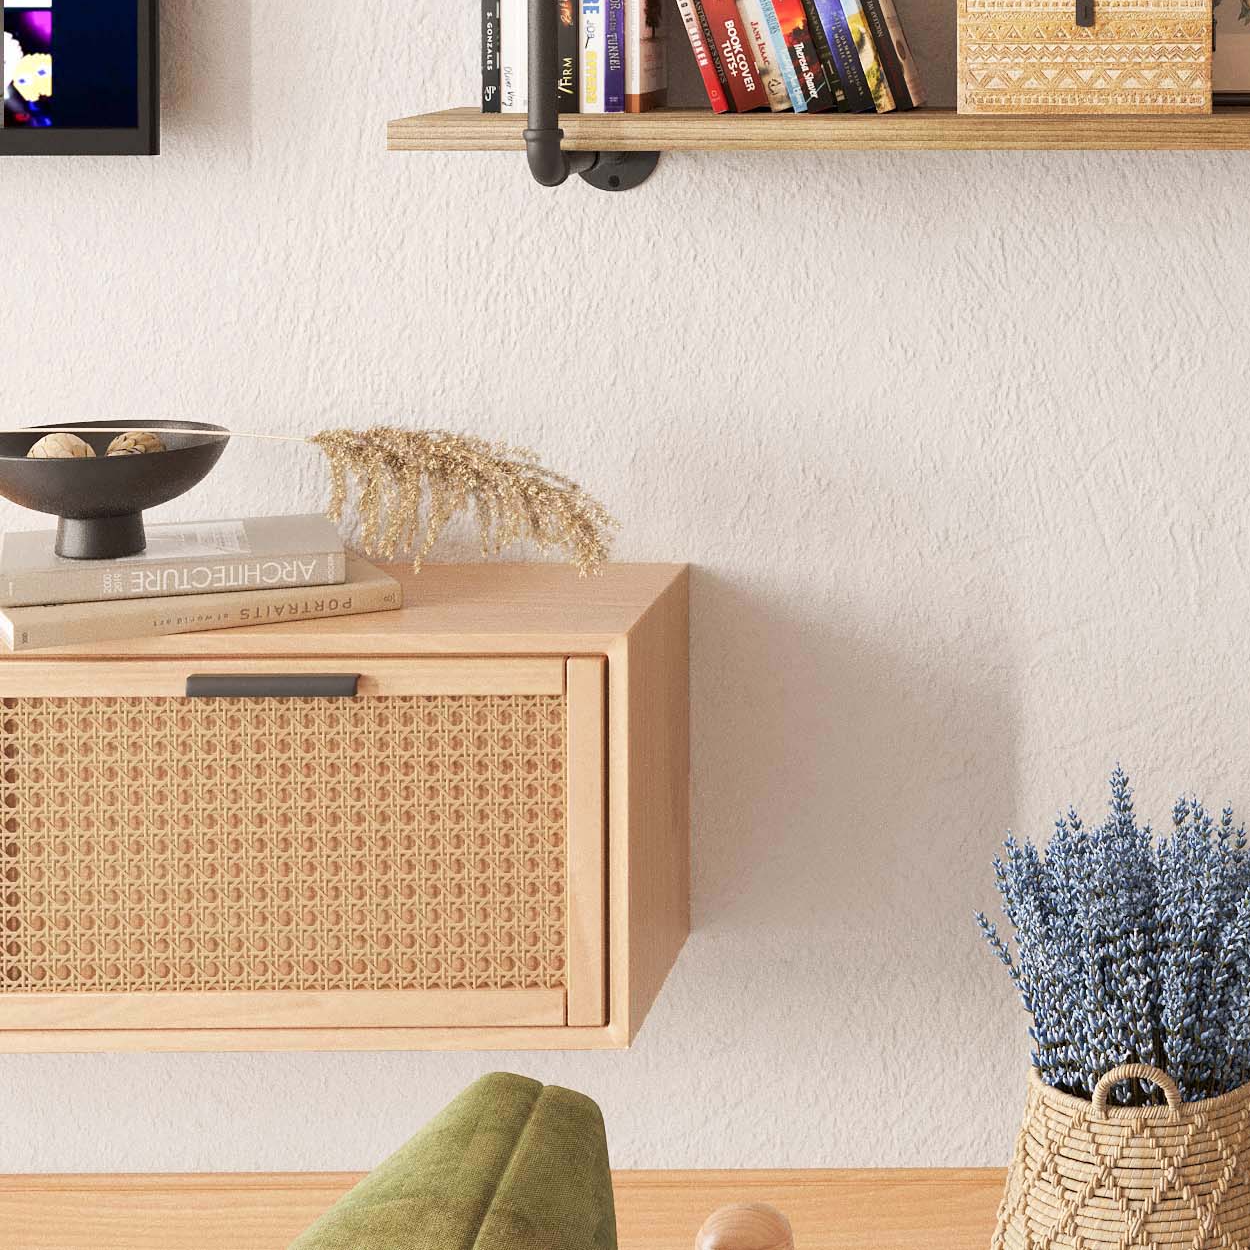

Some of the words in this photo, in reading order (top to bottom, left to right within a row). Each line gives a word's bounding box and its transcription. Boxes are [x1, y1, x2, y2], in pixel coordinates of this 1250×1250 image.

[686, 12, 693, 23] IS
[688, 27, 708, 66] BROKEN
[724, 19, 741, 51] BOOK
[734, 51, 755, 91] COVER
[751, 22, 762, 40] JANE
[758, 43, 770, 65] ISAAC
[794, 42, 809, 71] Theresa
[804, 73, 818, 99] Shaver
[130, 560, 317, 592] ARCHITECTURE
[240, 597, 352, 620] PORTRAITS
